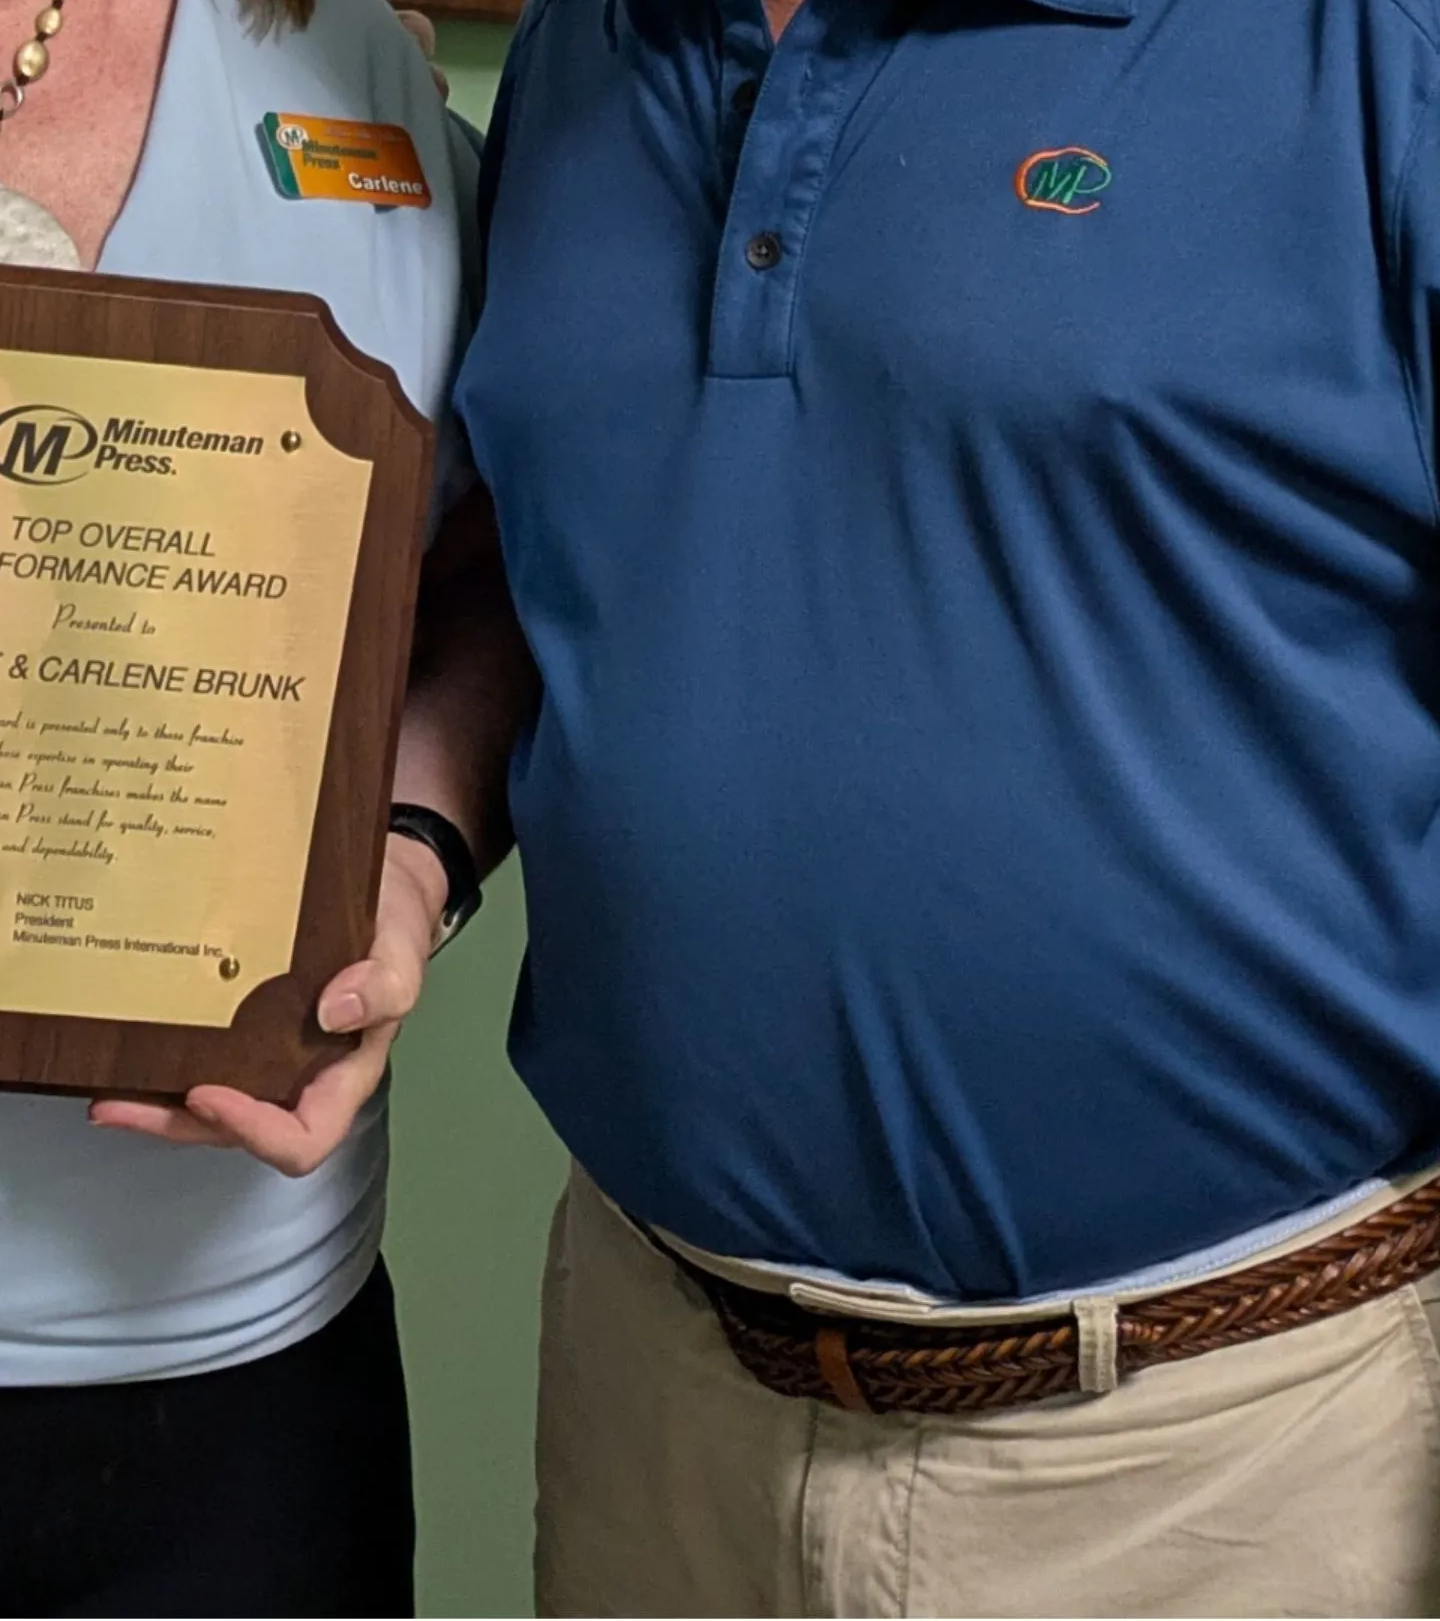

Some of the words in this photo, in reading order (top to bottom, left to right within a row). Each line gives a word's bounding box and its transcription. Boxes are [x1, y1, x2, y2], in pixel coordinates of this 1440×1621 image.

[348, 172, 423, 195] Carlene
[102, 418, 264, 455] Minuteman
[94, 444, 177, 476] Press.
[12, 516, 73, 544] TOP
[79, 522, 216, 557] OVERALL
[172, 567, 288, 600] AWARD
[52, 602, 137, 636] Presented
[141, 618, 156, 635] to
[8, 654, 28, 679] &
[38, 656, 191, 693] CARLENE
[193, 668, 306, 701] BRUNK
[25, 716, 36, 730] is
[40, 716, 100, 735] presented
[104, 718, 130, 741] only
[137, 725, 148, 738] to
[154, 723, 184, 741] those
[188, 725, 245, 747] franchise
[27, 750, 76, 766] expertise
[82, 752, 96, 766] in
[101, 755, 159, 776] operating
[165, 755, 195, 773] their
[19, 773, 54, 793] Press
[59, 776, 122, 799] franchises
[126, 783, 165, 801] makes
[170, 785, 189, 804] the
[194, 794, 227, 807] name
[16, 803, 51, 825] Press
[57, 809, 91, 827] stand
[96, 813, 114, 831] for
[120, 814, 169, 838] quality,
[173, 822, 216, 839] service,
[1, 837, 26, 853] and
[32, 837, 119, 865] dependability.
[16, 893, 51, 908] NICK
[54, 895, 94, 911] TITUS
[15, 911, 75, 929] President
[12, 930, 82, 948] Minuteman
[85, 935, 122, 951] Press
[124, 937, 200, 957] International
